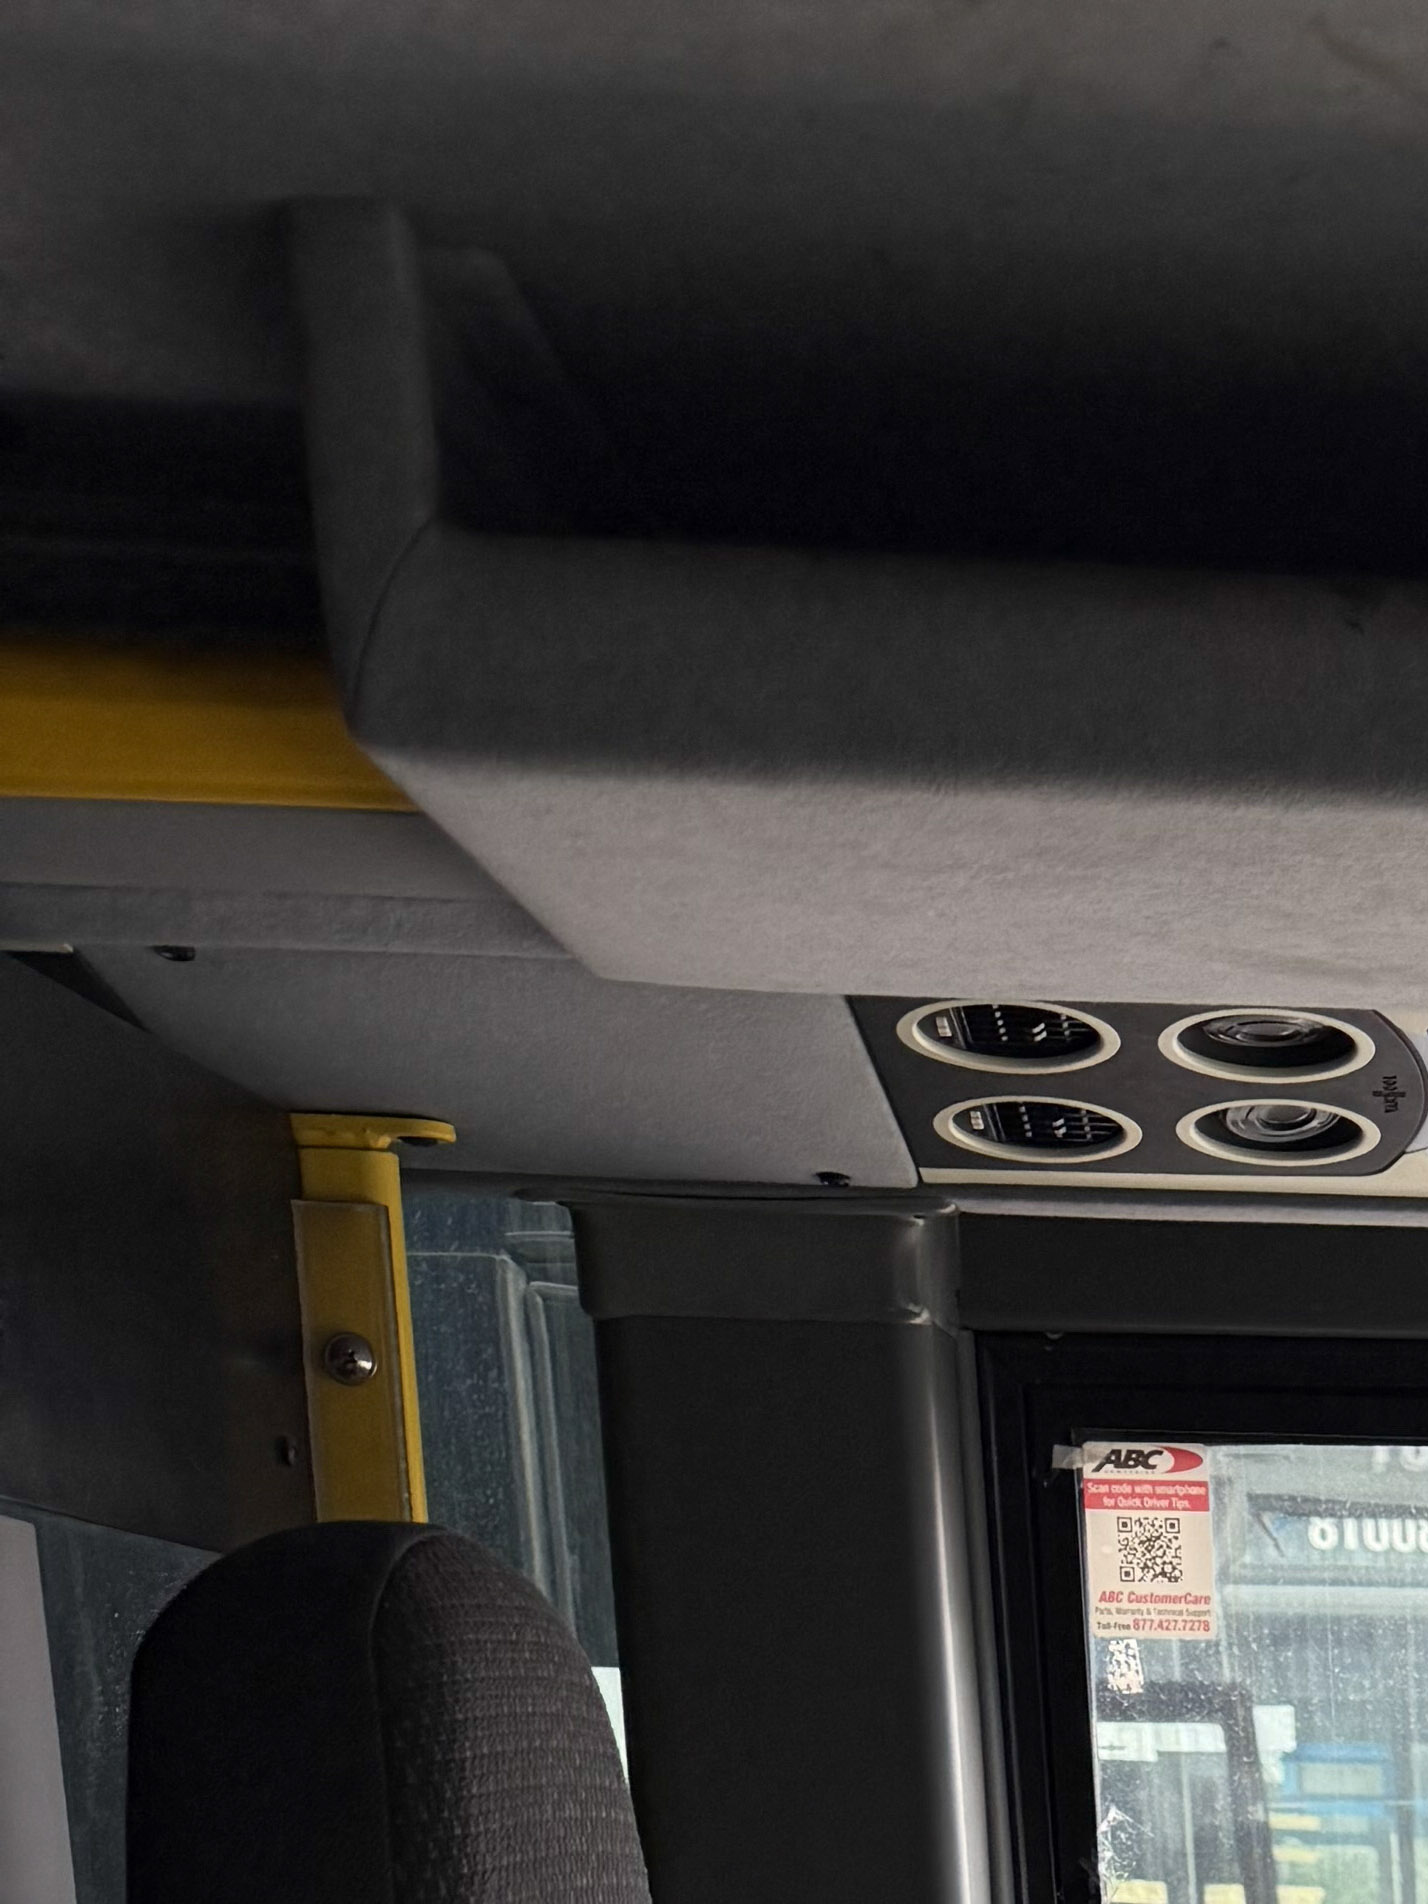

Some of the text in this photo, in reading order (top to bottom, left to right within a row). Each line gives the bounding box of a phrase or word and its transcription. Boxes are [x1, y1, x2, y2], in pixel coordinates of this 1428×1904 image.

[1092, 1447, 1163, 1473] ABC
[1088, 1482, 1206, 1496] Scan code with smartphone
[1103, 1496, 1169, 1508] for Quick Driver
[1099, 1592, 1211, 1605] ABC CustomerCare
[1133, 1619, 1210, 1632] 877.427.7278
